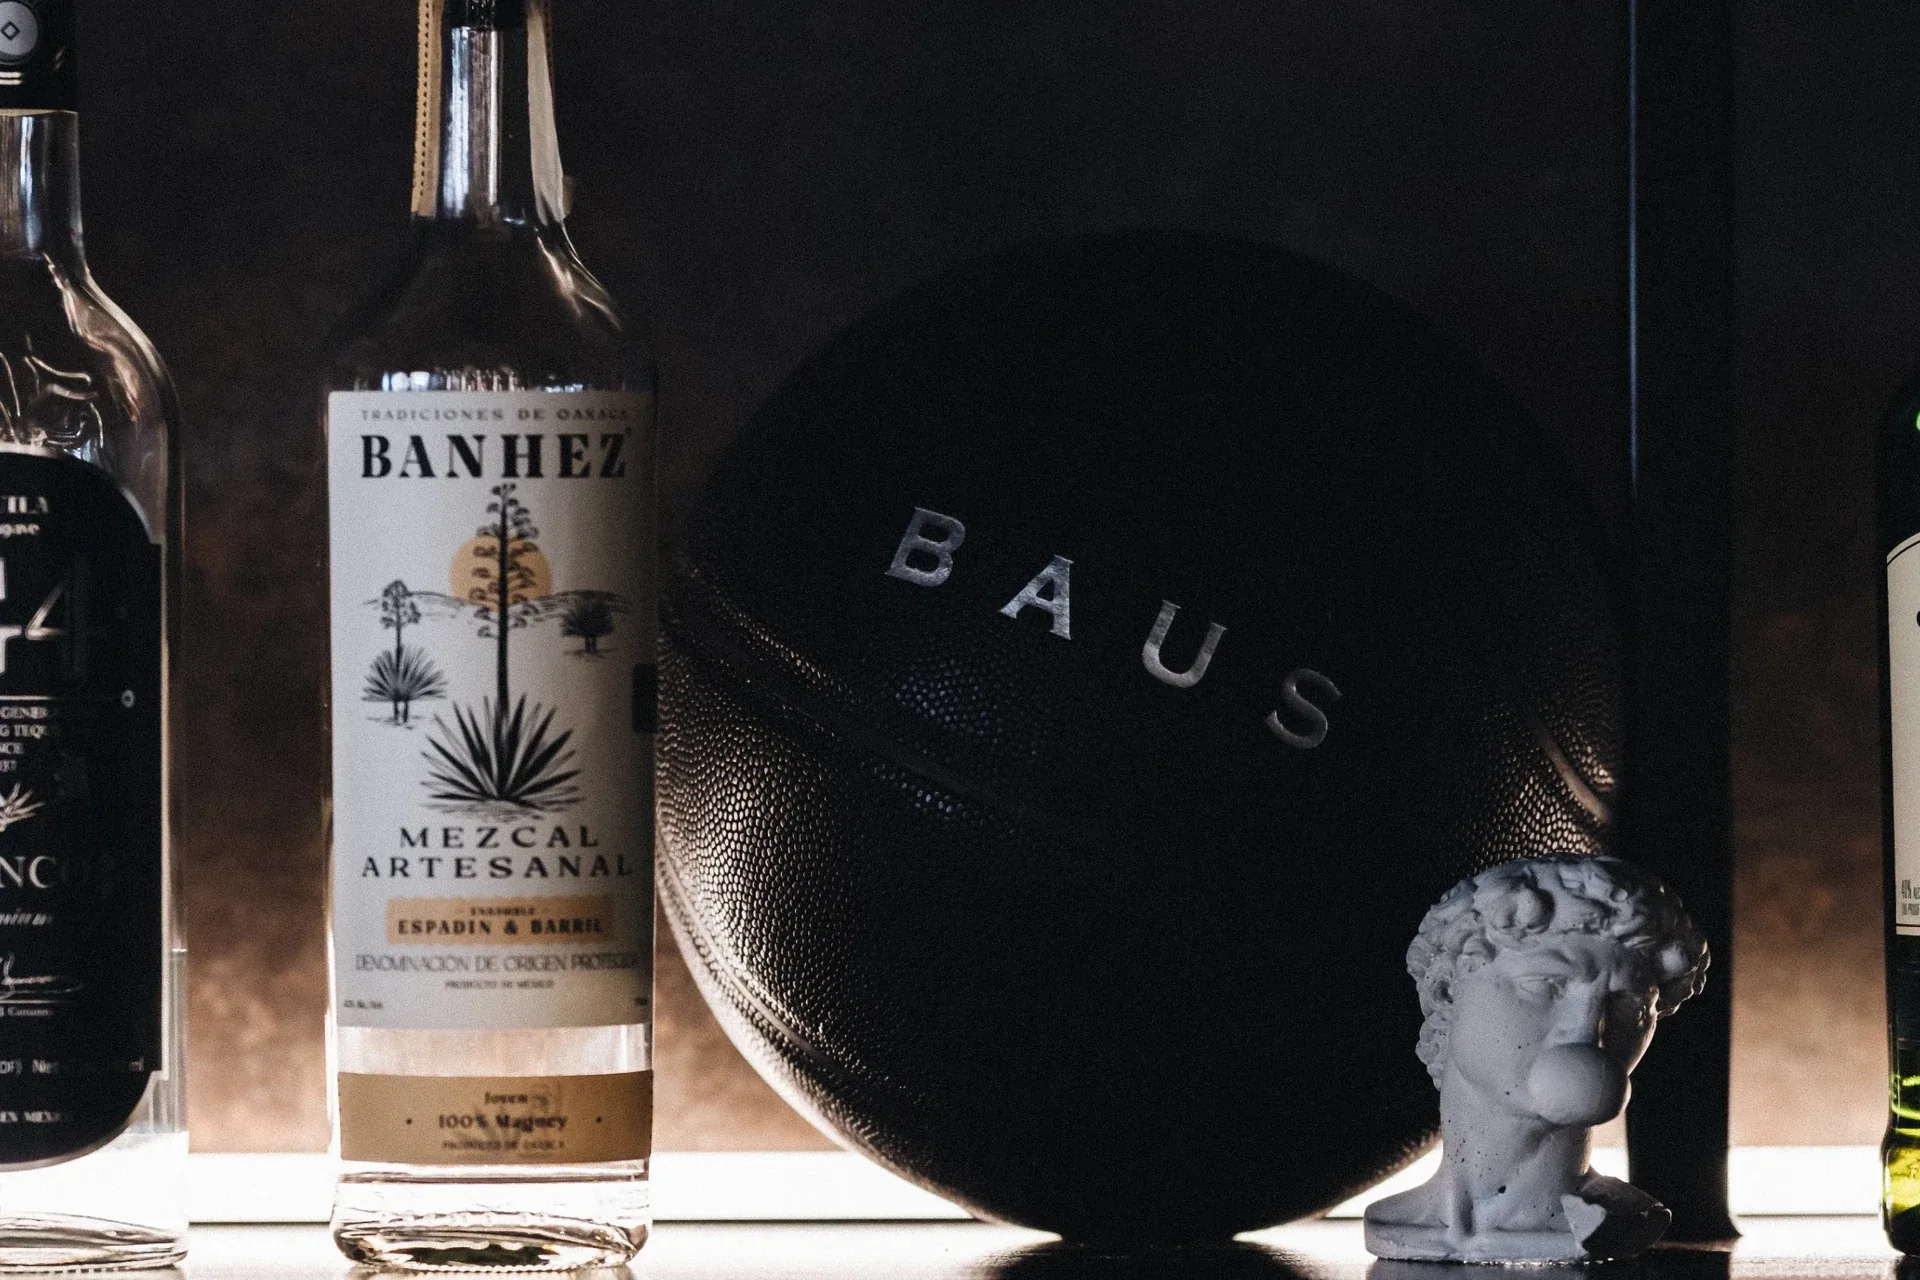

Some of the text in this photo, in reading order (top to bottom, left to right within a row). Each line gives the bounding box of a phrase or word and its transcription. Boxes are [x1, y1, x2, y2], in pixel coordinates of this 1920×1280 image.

[361, 408, 505, 422] TRADICIONES
[517, 408, 546, 421] DE
[361, 434, 627, 478] BANHEZ
[885, 507, 1343, 749] BAUS
[400, 826, 600, 848] MEZCAL
[361, 855, 634, 879] ARTESANAL
[398, 919, 491, 935] ESPADIN
[504, 919, 518, 935] &
[475, 955, 498, 972] DE
[503, 955, 567, 971] ORIGEN
